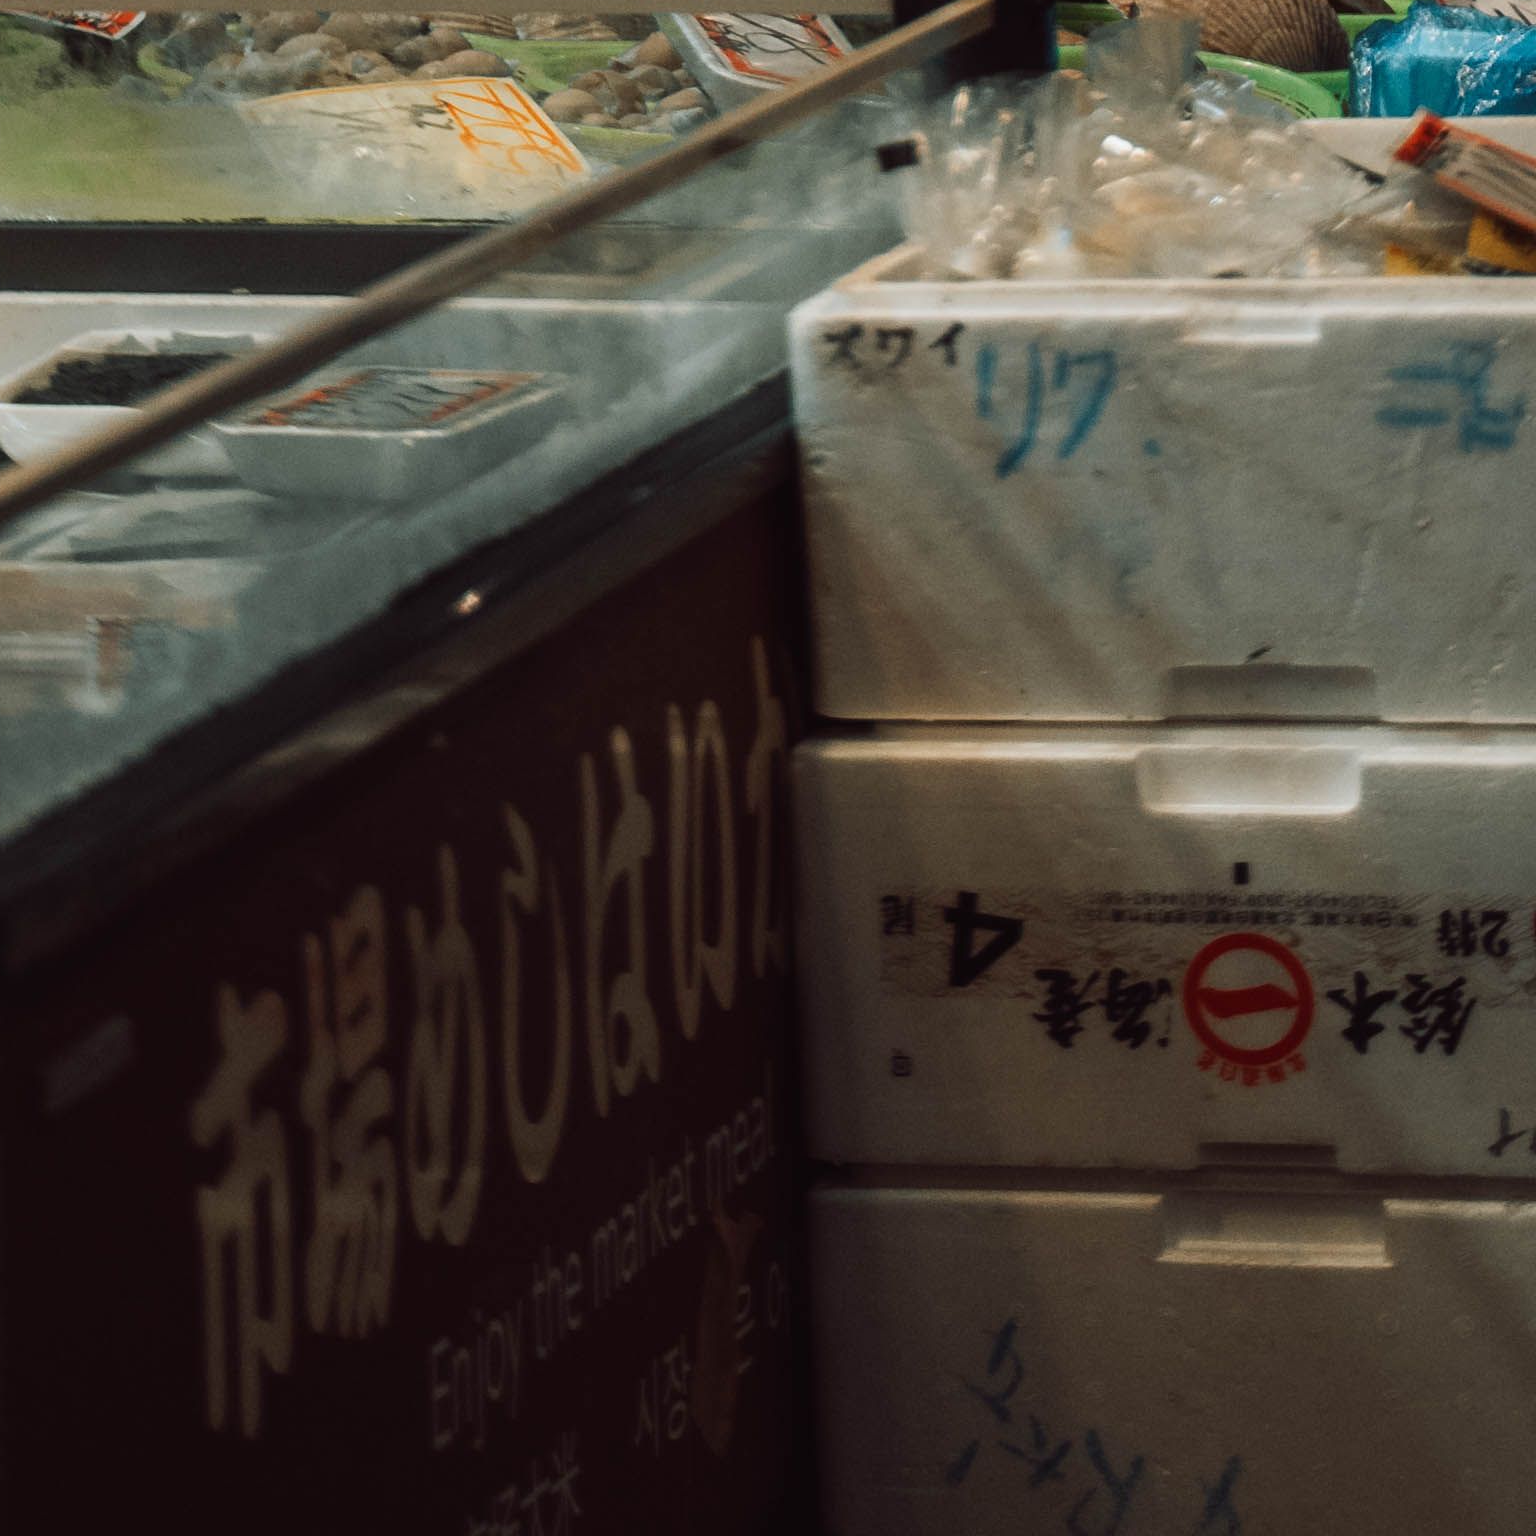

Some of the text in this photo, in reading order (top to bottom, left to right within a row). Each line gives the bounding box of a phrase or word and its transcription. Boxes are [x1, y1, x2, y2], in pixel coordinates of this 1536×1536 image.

[431, 1296, 523, 1452] Enjoy
[531, 1244, 583, 1360] the
[592, 1133, 699, 1309] market
